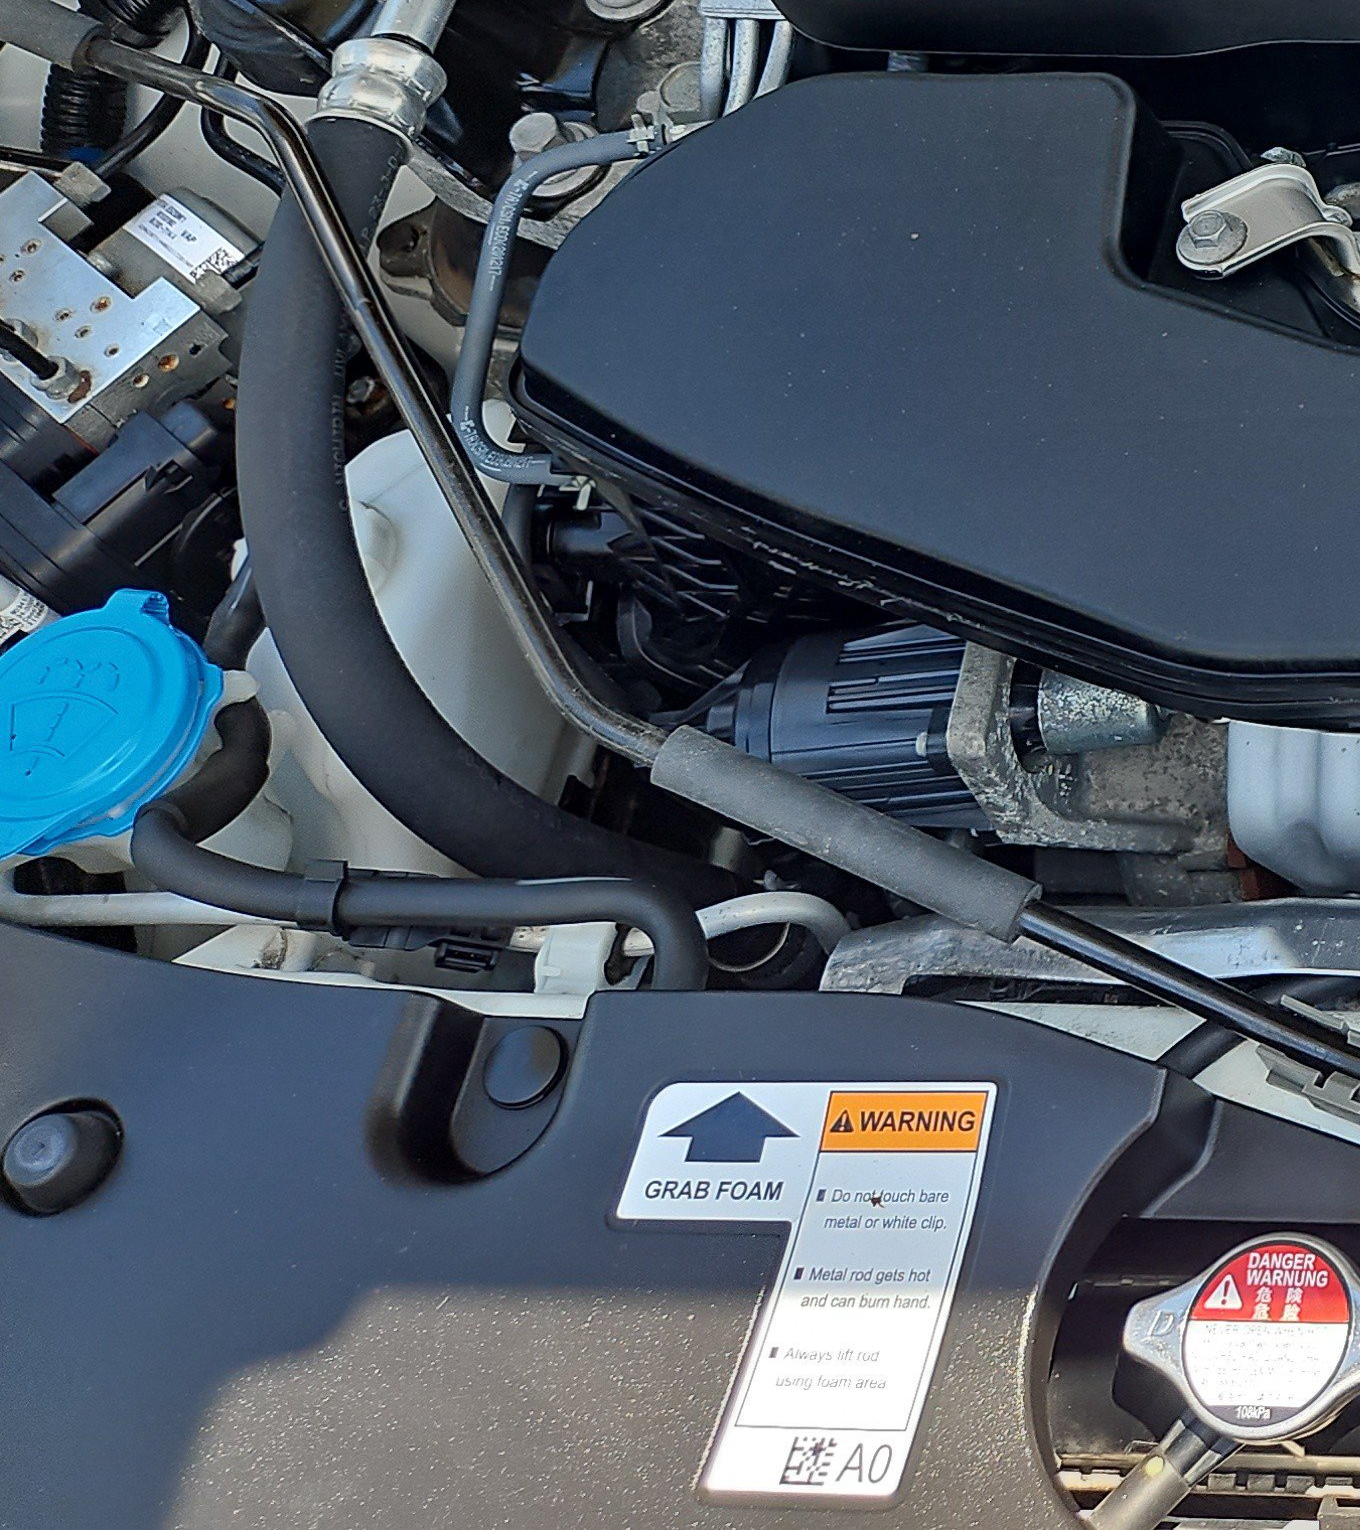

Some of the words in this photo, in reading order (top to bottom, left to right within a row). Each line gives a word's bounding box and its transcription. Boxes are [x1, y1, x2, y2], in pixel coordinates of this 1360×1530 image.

[860, 1110, 976, 1133] WARNING
[644, 1181, 709, 1200] GRAB
[715, 1181, 784, 1201] FOAM
[831, 1189, 848, 1204] Do
[850, 1189, 877, 1205] not
[878, 1188, 916, 1205] touch
[919, 1189, 950, 1204] bare
[823, 1216, 863, 1230] metal
[865, 1218, 879, 1230] or
[882, 1216, 917, 1230] white
[920, 1216, 948, 1233] clip.
[1247, 1253, 1316, 1270] DANGER
[809, 1268, 847, 1282] Metal
[849, 1268, 873, 1282] rod
[875, 1269, 905, 1285] gets
[908, 1269, 931, 1283] hot
[1246, 1269, 1328, 1287] WARNUNG
[801, 1293, 827, 1308] and
[830, 1296, 855, 1308] can
[859, 1293, 891, 1309] burn
[893, 1294, 931, 1310] hand.
[784, 1347, 833, 1363] Always
[837, 1348, 853, 1362] lift
[857, 1348, 881, 1362] rod
[775, 1375, 813, 1391] using
[817, 1375, 851, 1388] foam
[855, 1378, 887, 1390] area
[835, 1442, 893, 1484] A0
